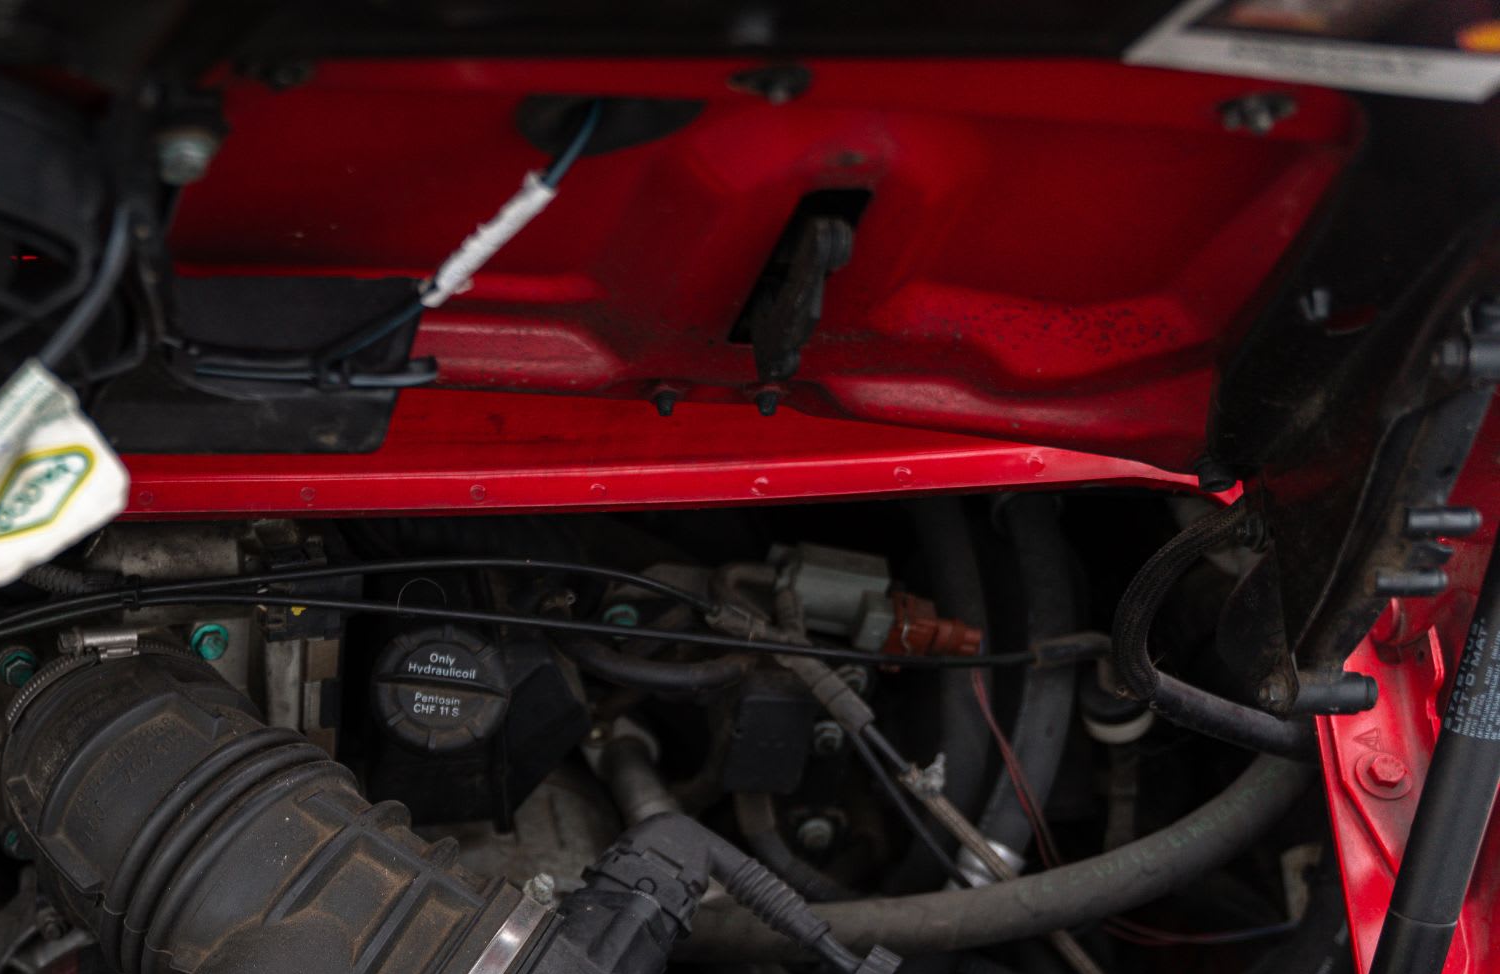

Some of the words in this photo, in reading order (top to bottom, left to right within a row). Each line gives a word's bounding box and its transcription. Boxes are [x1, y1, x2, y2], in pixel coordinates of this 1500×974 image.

[429, 653, 456, 666] Only
[408, 661, 476, 679] Hydraulicoil
[414, 692, 460, 706] Pentosin
[413, 703, 436, 715] CHF
[439, 706, 449, 717] 11
[451, 707, 460, 718] S
